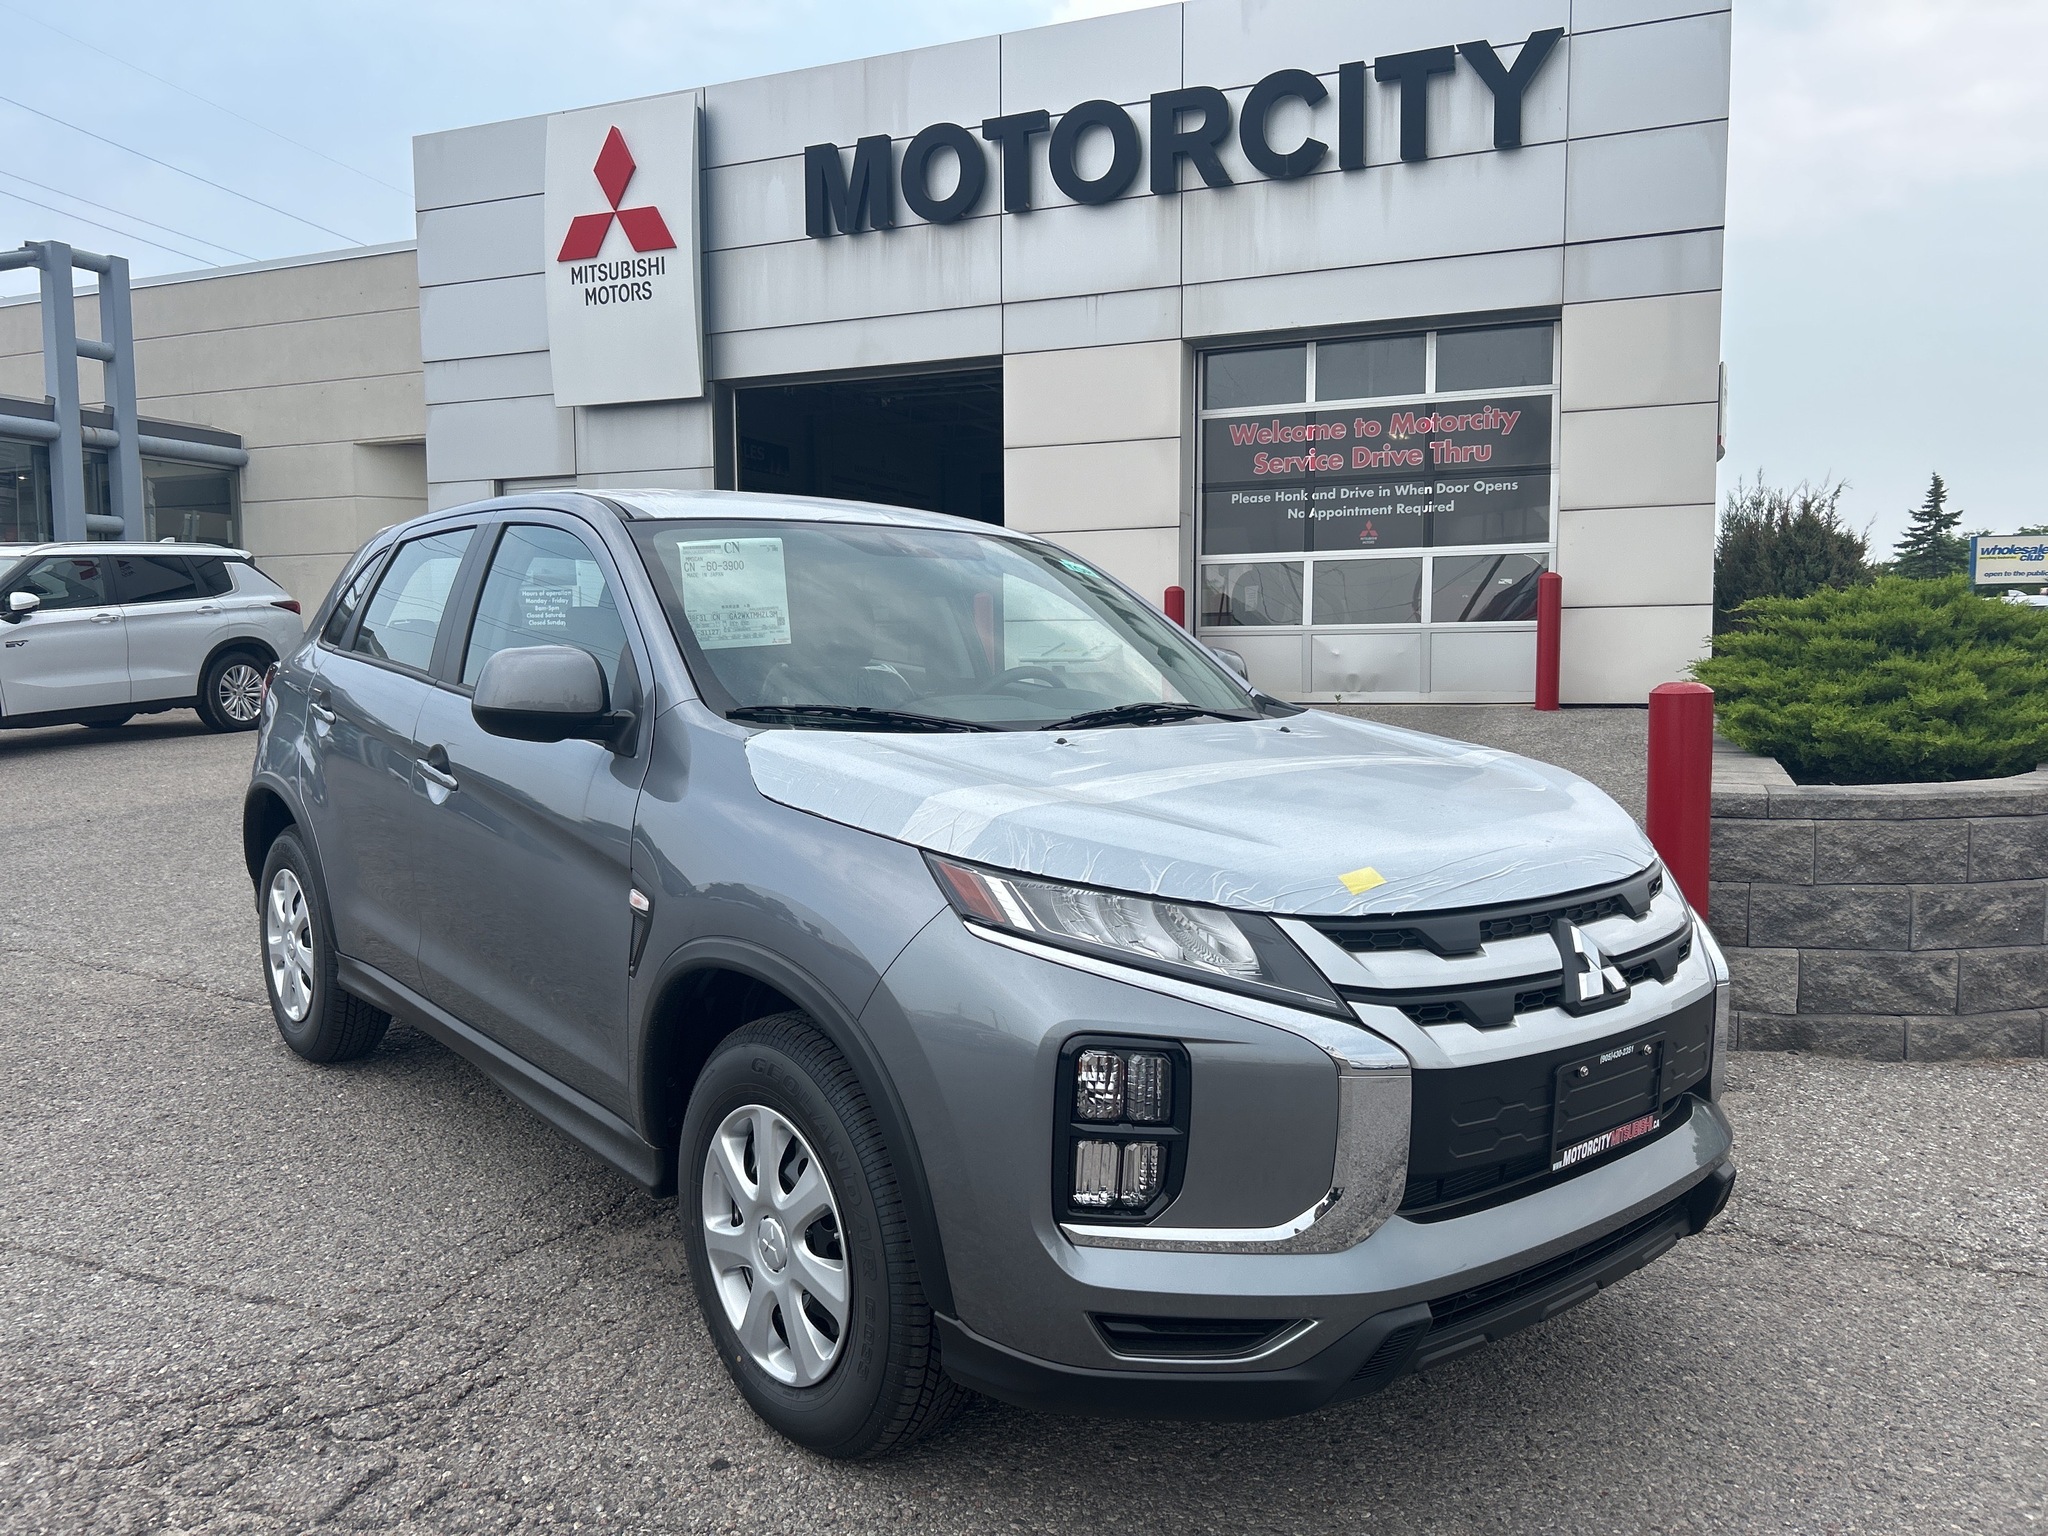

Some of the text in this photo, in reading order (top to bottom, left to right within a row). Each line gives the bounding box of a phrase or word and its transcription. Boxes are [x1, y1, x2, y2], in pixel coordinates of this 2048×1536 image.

[805, 27, 1565, 238] MOTORCITY
[571, 256, 665, 285] MITSUBISHI
[585, 281, 652, 306] MOTORS
[1229, 405, 1521, 446] Welcome to Motorcity
[1253, 439, 1492, 475] Service Drive Thru
[1231, 480, 1519, 504] Please Honk and Drive in When Door Opens
[1287, 500, 1455, 521] No Appointment Required
[724, 541, 741, 554] CN
[1981, 544, 2048, 555] wholesale
[2020, 553, 2044, 561] club
[683, 562, 696, 573] CN
